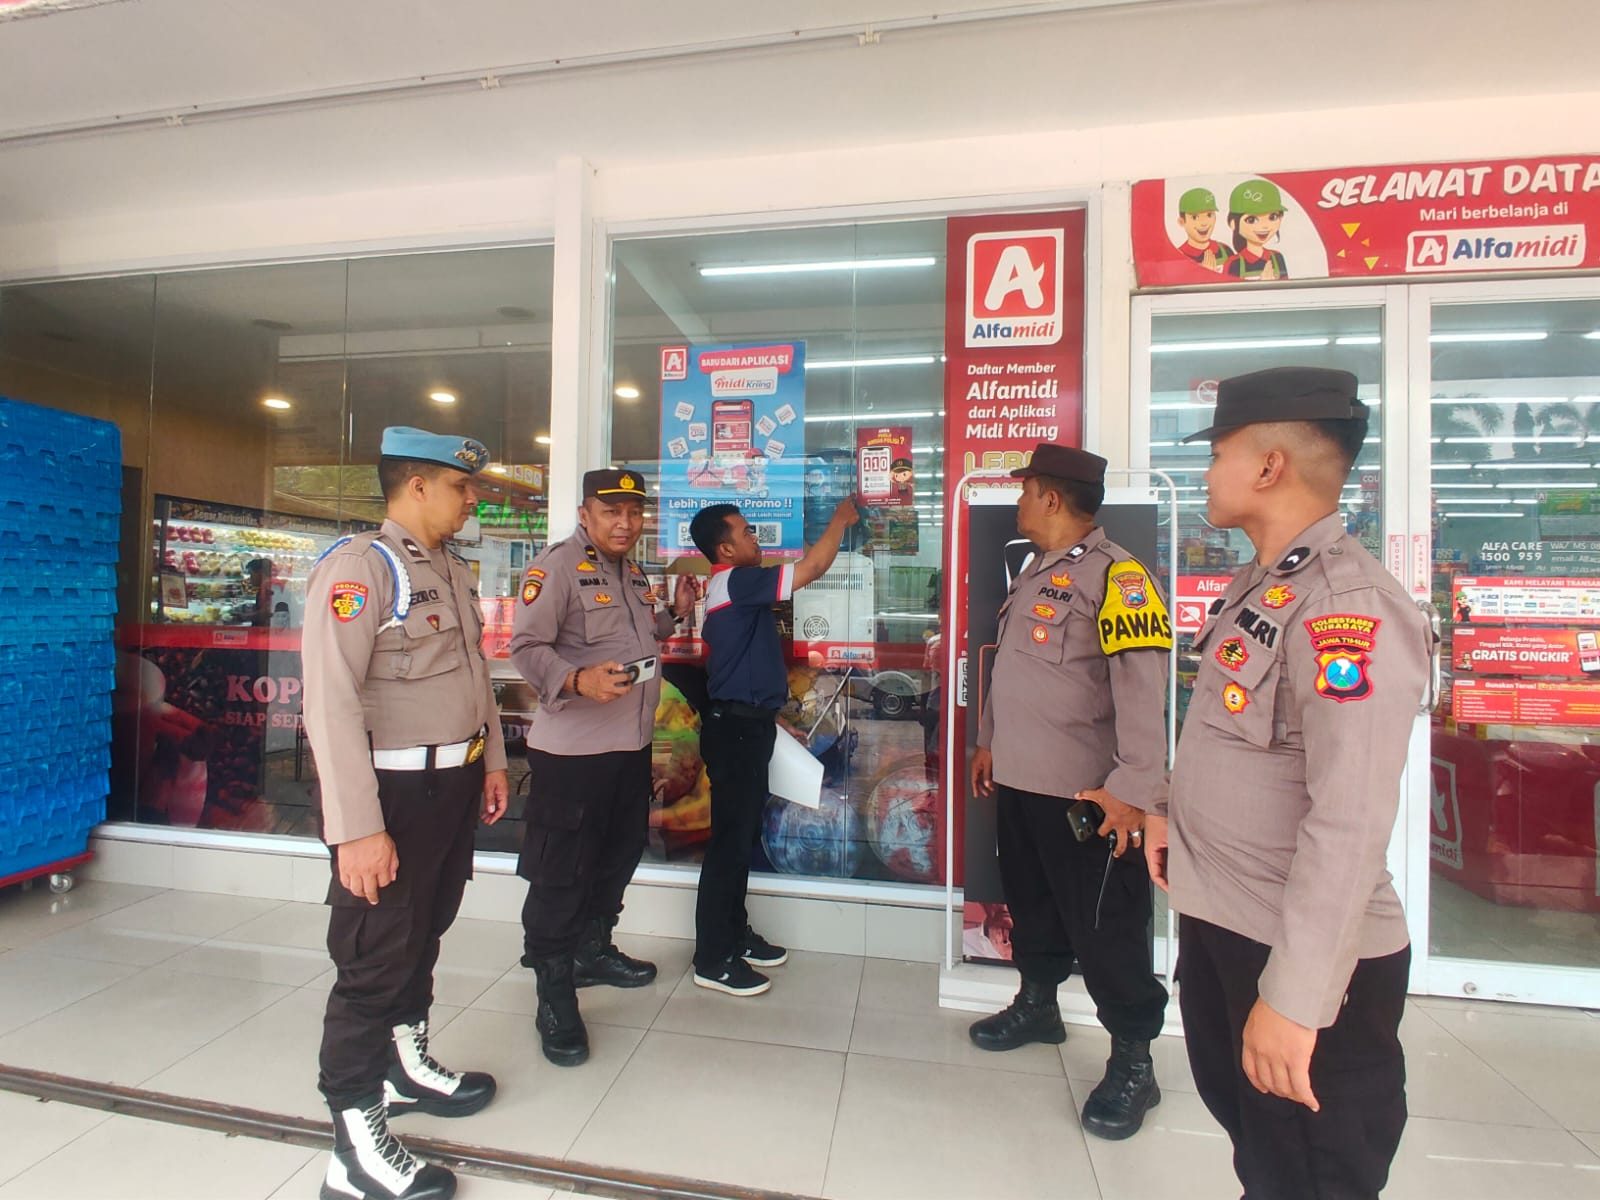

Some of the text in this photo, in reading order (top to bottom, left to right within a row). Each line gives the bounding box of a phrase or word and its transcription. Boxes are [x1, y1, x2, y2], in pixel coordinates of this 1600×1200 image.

[1317, 162, 1600, 209] SELAMAT DATA
[1420, 201, 1569, 222] Mari berbelanja di
[1452, 233, 1578, 260] Alfamidi
[972, 321, 1056, 339] Alfamidi
[701, 354, 789, 367] BARU DARI APLIKASI
[967, 362, 1056, 375] Daftar Member
[714, 376, 771, 390] midi Kriing
[966, 379, 1058, 401] Alfamidi
[968, 404, 1056, 421] dari Aplikasi
[965, 422, 1059, 441] Midi Kriing
[864, 457, 888, 471] 110
[668, 498, 698, 509] Lebih
[744, 499, 782, 509] Promo
[1481, 541, 1543, 551] ALFA CARE
[1480, 552, 1543, 562] 1500 959
[1038, 586, 1074, 603] POLRI
[1100, 611, 1173, 644] PAWAS
[1235, 607, 1279, 649] POLRI
[1313, 623, 1372, 634] SURABAYA
[1317, 637, 1371, 648] JAWA TIMUR
[1471, 649, 1517, 661] GRATIS
[224, 711, 266, 727] SIAP
